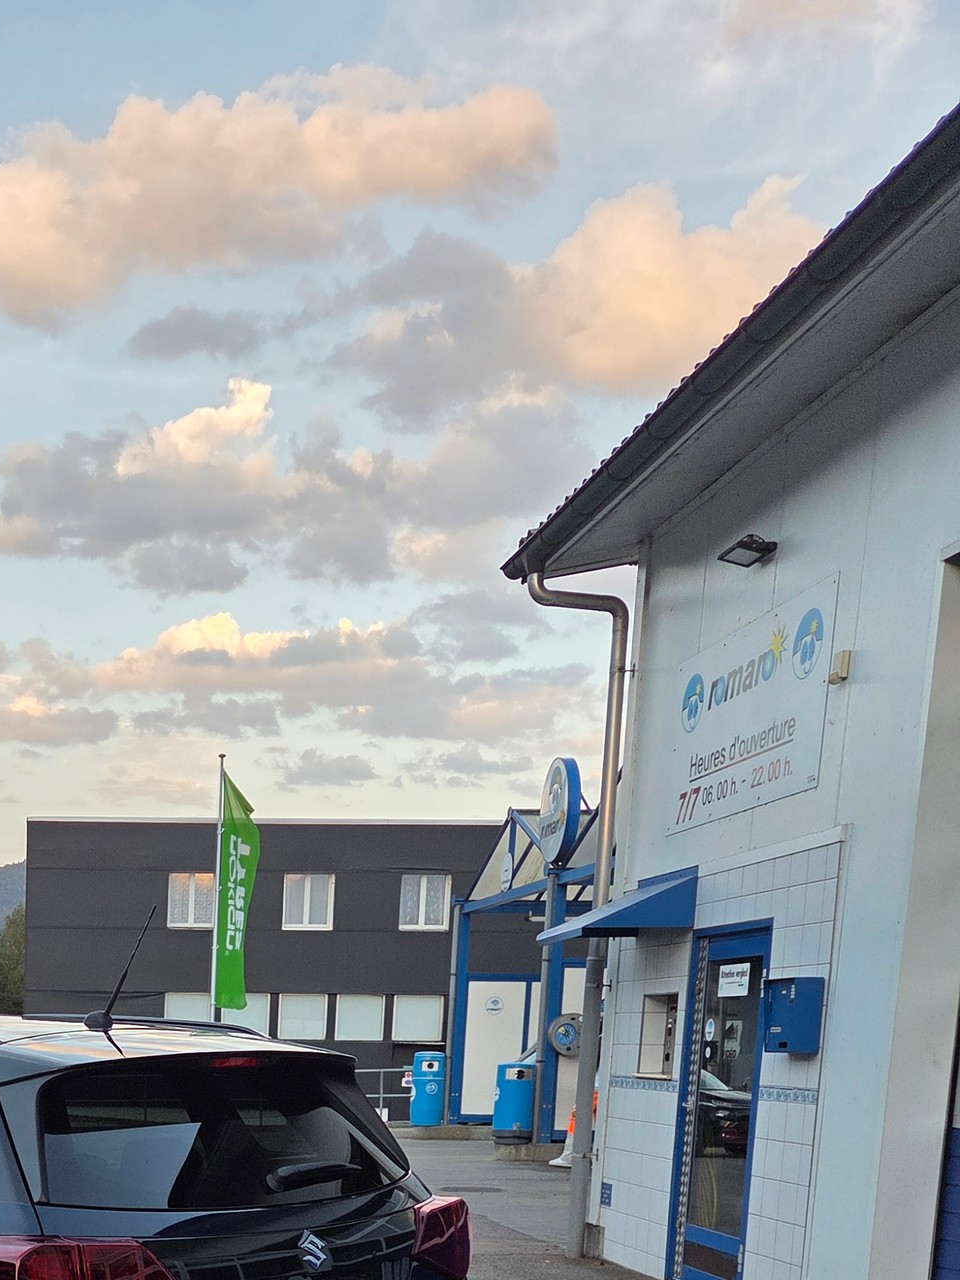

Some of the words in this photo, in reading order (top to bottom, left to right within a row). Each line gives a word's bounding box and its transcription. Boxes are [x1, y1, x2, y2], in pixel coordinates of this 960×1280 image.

[707, 649, 775, 711] romaro
[689, 747, 726, 778] Heures
[729, 717, 796, 762] d'ouverture
[676, 786, 701, 826] 7/7
[730, 777, 738, 796] h.
[783, 756, 793, 777] h.
